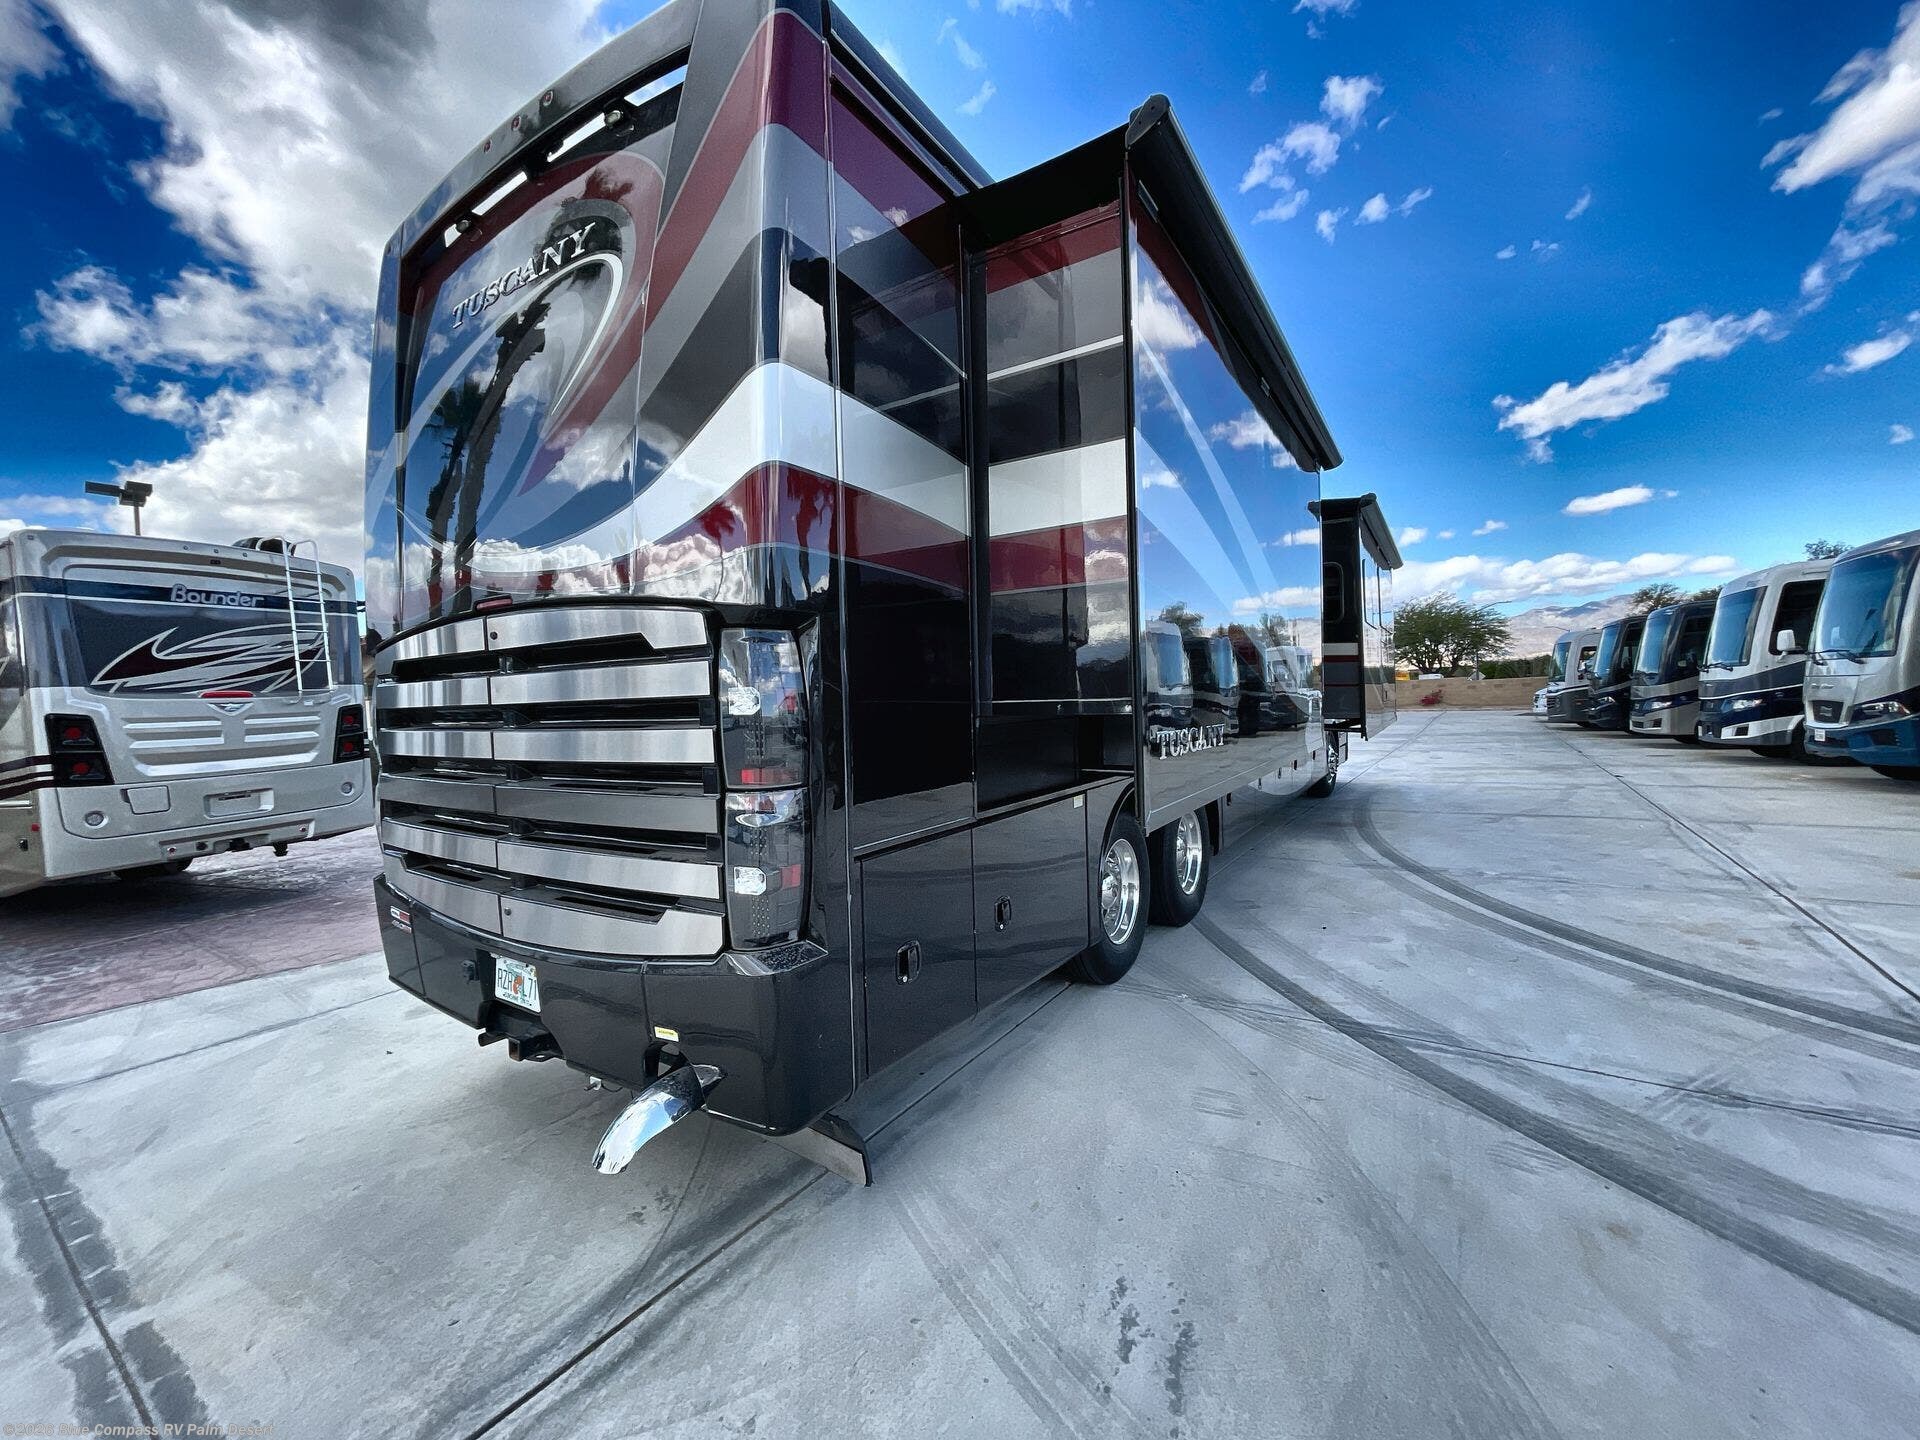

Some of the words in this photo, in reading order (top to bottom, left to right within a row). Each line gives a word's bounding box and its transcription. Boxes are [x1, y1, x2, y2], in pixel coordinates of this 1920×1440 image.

[453, 222, 596, 329] TUSCANY
[170, 583, 265, 608] Bounder
[1156, 723, 1225, 760] TUSCANY
